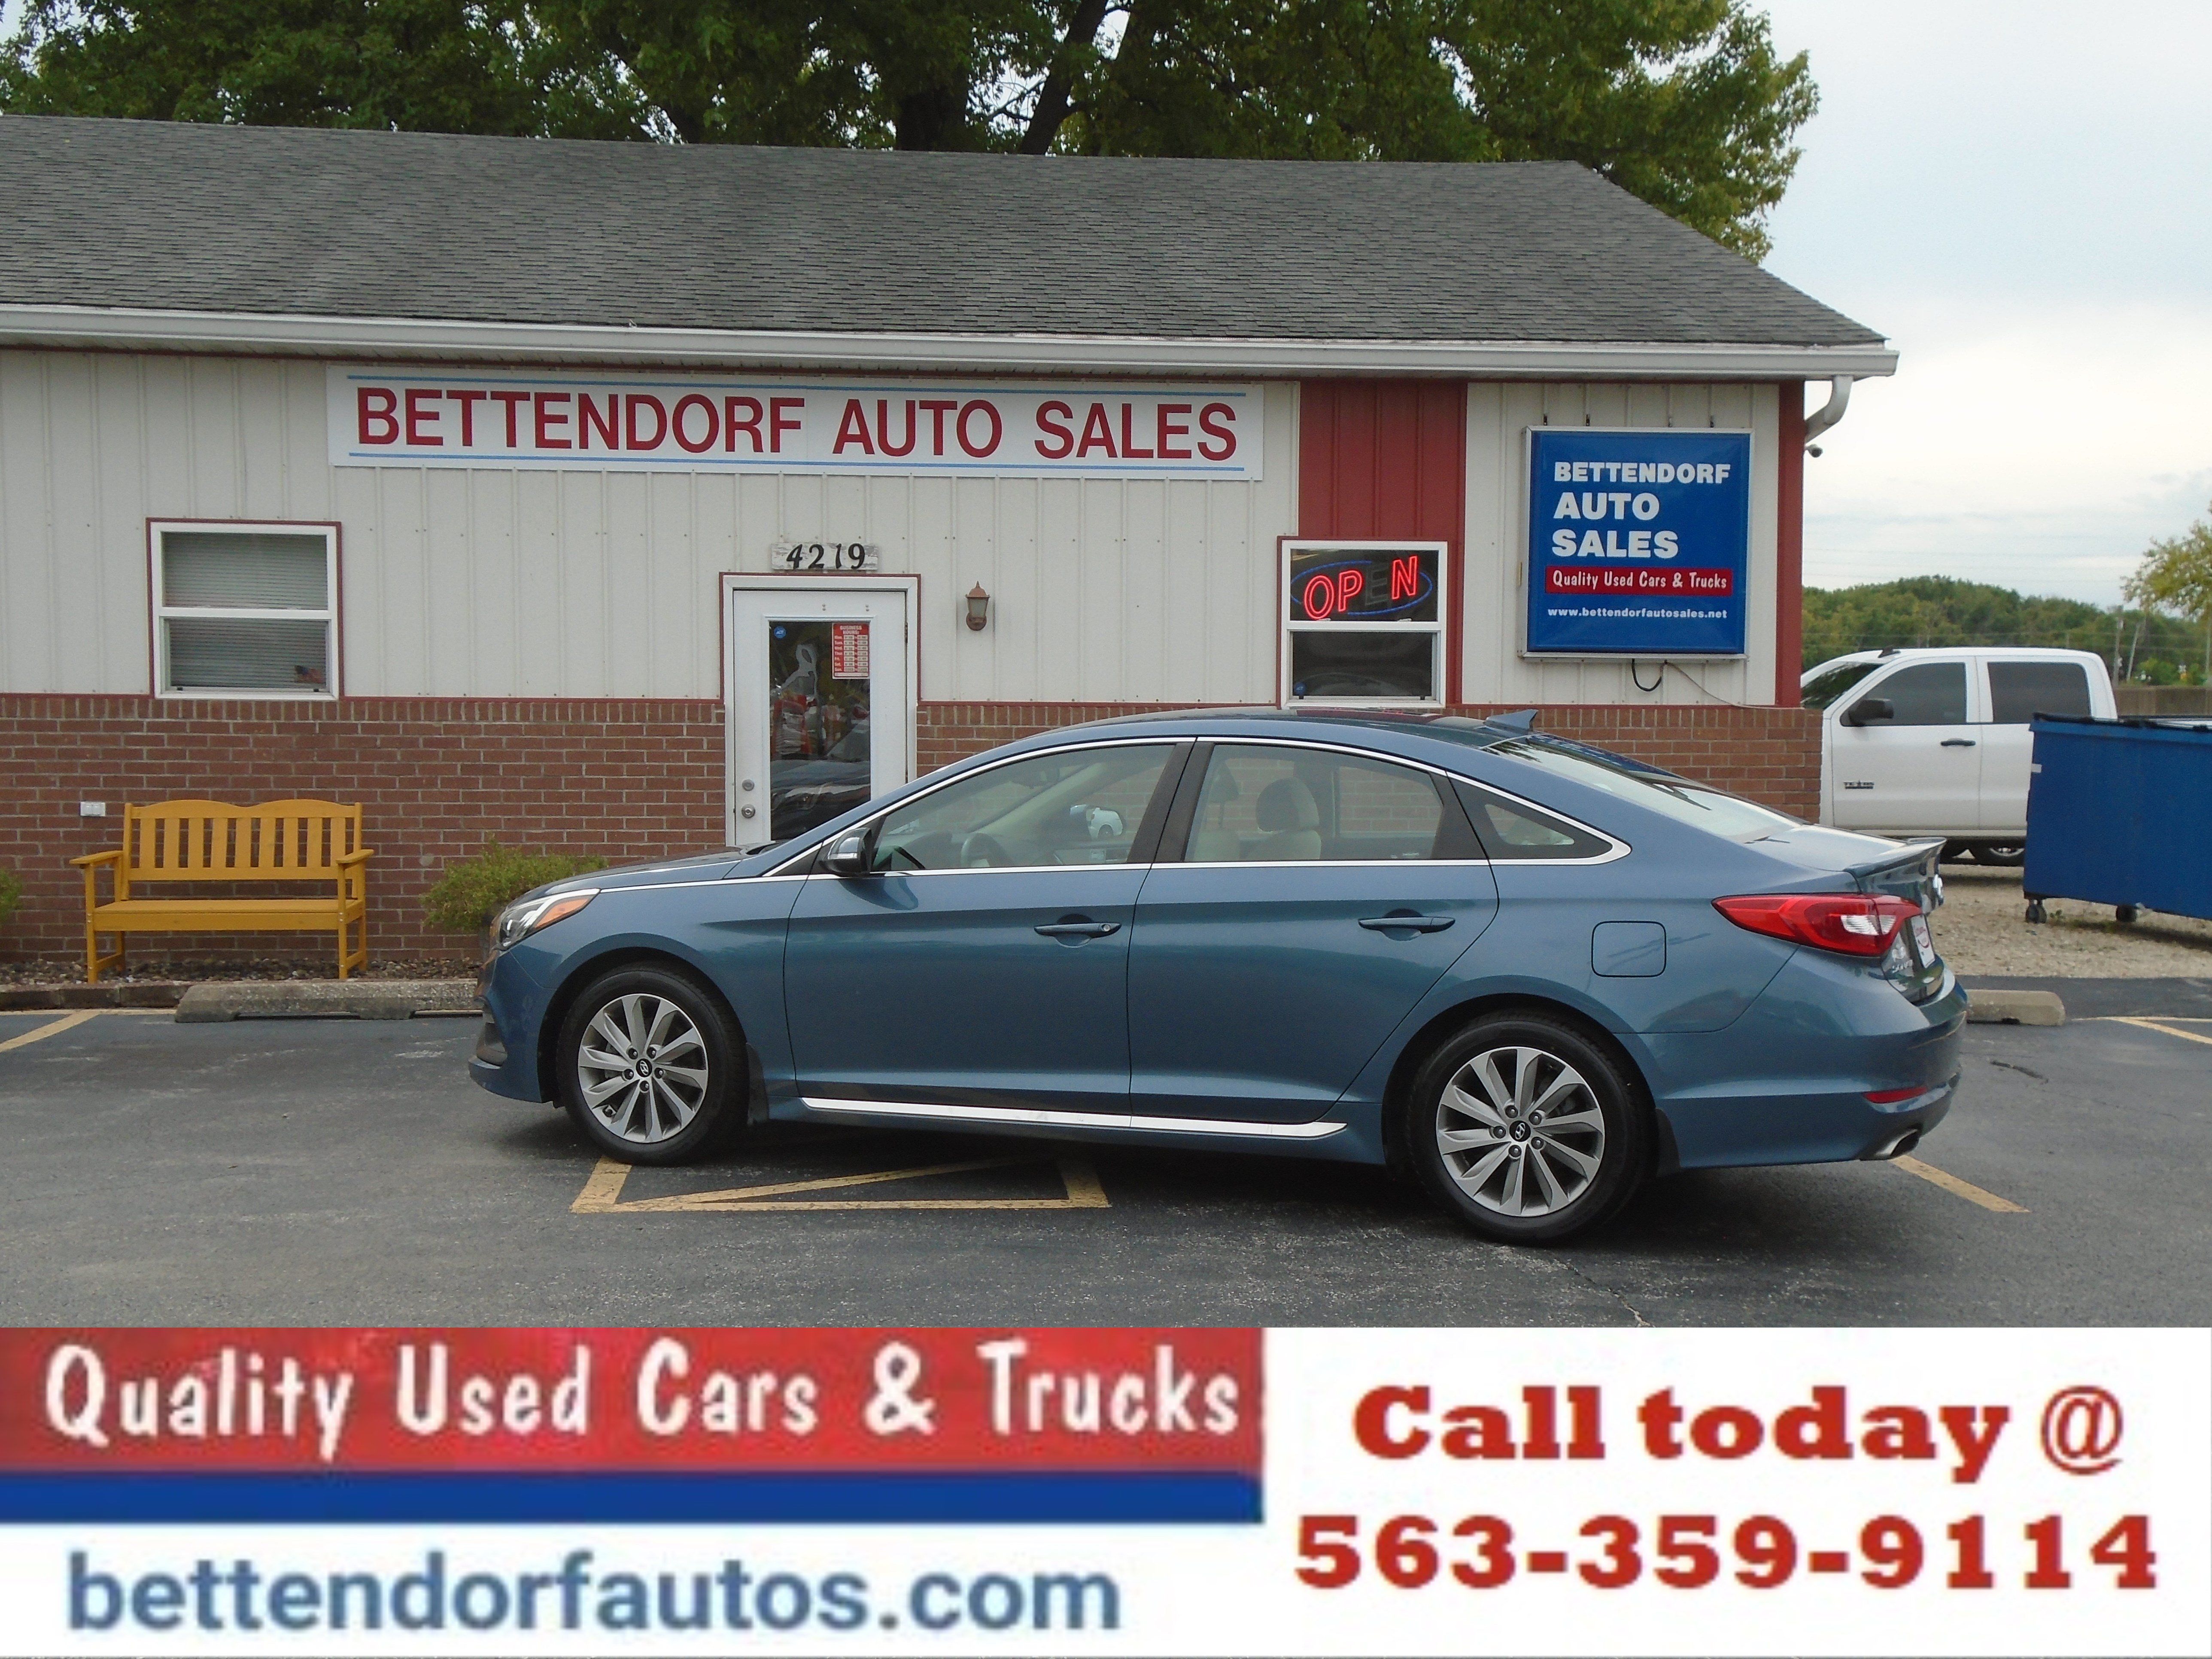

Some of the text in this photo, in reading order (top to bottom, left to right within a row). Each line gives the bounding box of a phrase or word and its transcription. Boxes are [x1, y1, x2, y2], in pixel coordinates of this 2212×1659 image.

[357, 387, 1237, 461] BETTENDORF AUTO SALES
[1554, 462, 1731, 484] BETTENDORF
[1553, 492, 1660, 520] AUTO
[786, 543, 866, 569] 4219
[1552, 529, 1678, 559] SALES
[1553, 570, 1727, 590] Quality Used Cars & Trucks
[1547, 607, 1728, 619] www.bettendorfautosales.net
